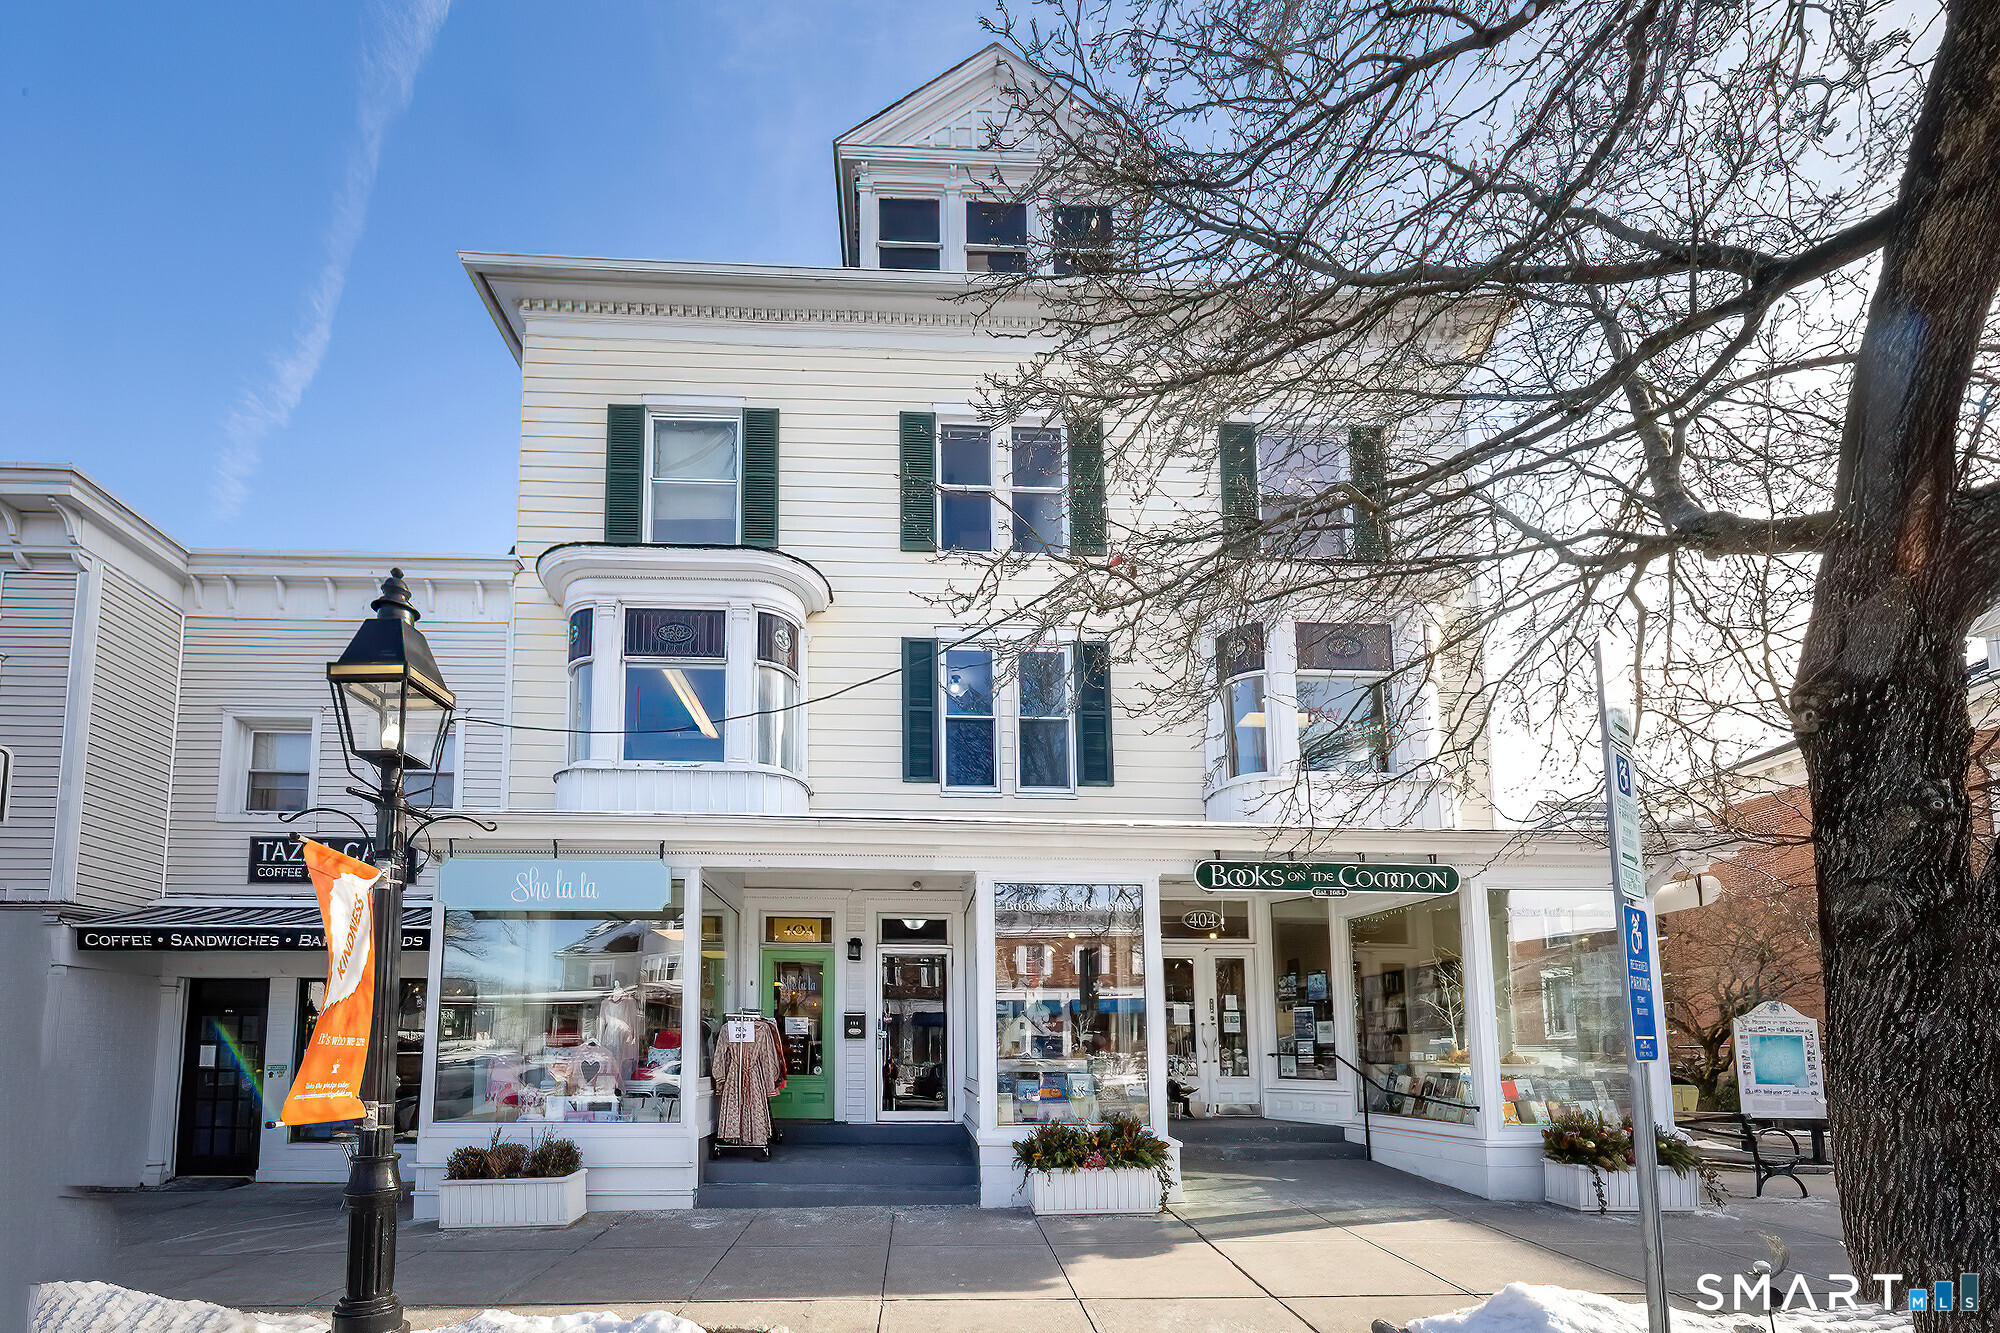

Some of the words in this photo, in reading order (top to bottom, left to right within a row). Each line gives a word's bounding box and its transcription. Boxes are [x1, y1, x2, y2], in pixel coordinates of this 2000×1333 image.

[257, 867, 303, 878] COFFEE
[511, 867, 550, 902] She
[556, 869, 576, 899] la
[580, 872, 599, 899] la
[1005, 900, 1043, 912] Books
[1057, 901, 1093, 912] Cards
[1188, 912, 1217, 927] 404
[337, 892, 364, 981] KINDNESS
[783, 925, 815, 937] 404
[85, 933, 152, 947] COFFEE
[170, 933, 280, 947] SANDWICHES
[1630, 975, 1650, 992] PARKING
[317, 1032, 331, 1045] It's
[331, 1034, 346, 1046] who
[347, 1036, 355, 1046] we
